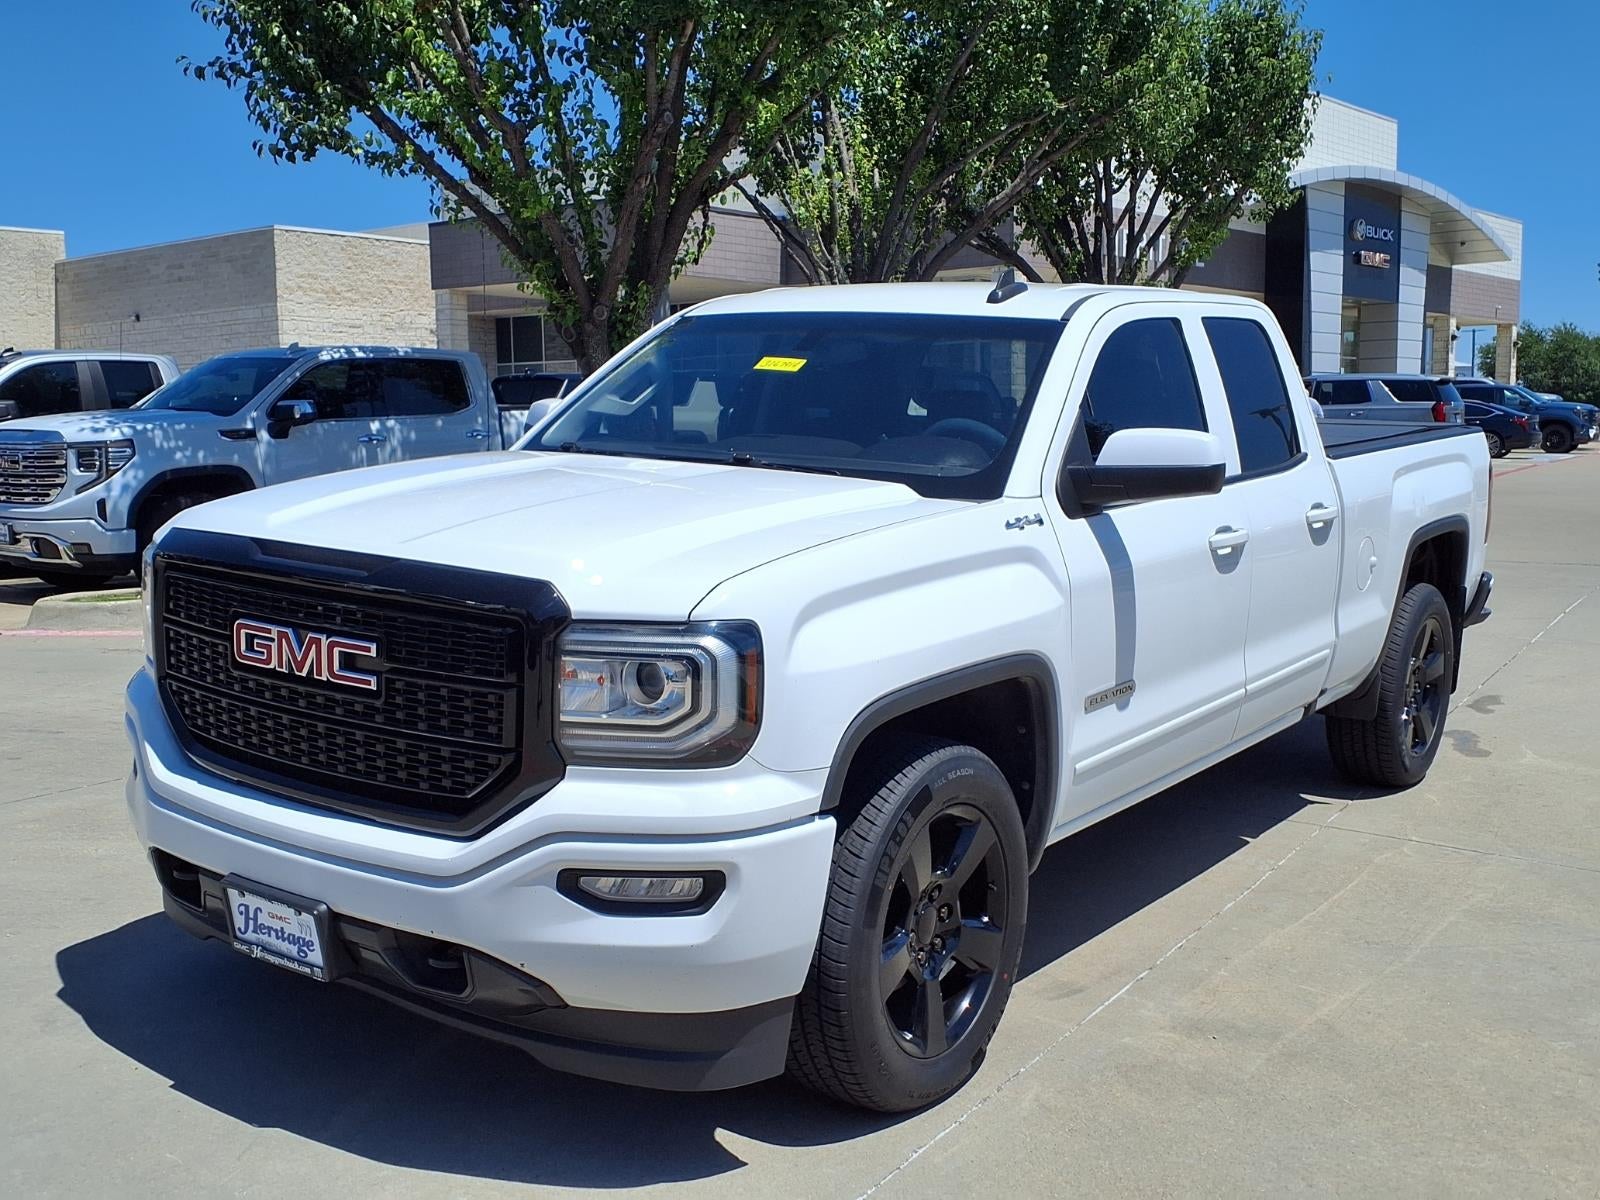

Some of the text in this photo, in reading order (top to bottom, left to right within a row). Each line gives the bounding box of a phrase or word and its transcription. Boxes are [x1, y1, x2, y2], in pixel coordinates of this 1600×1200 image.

[1366, 225, 1394, 241] BUICK
[234, 618, 377, 690] GMC
[1089, 683, 1133, 706] ELEVATION
[947, 767, 974, 781] SEASON
[237, 903, 316, 959] Heritage
